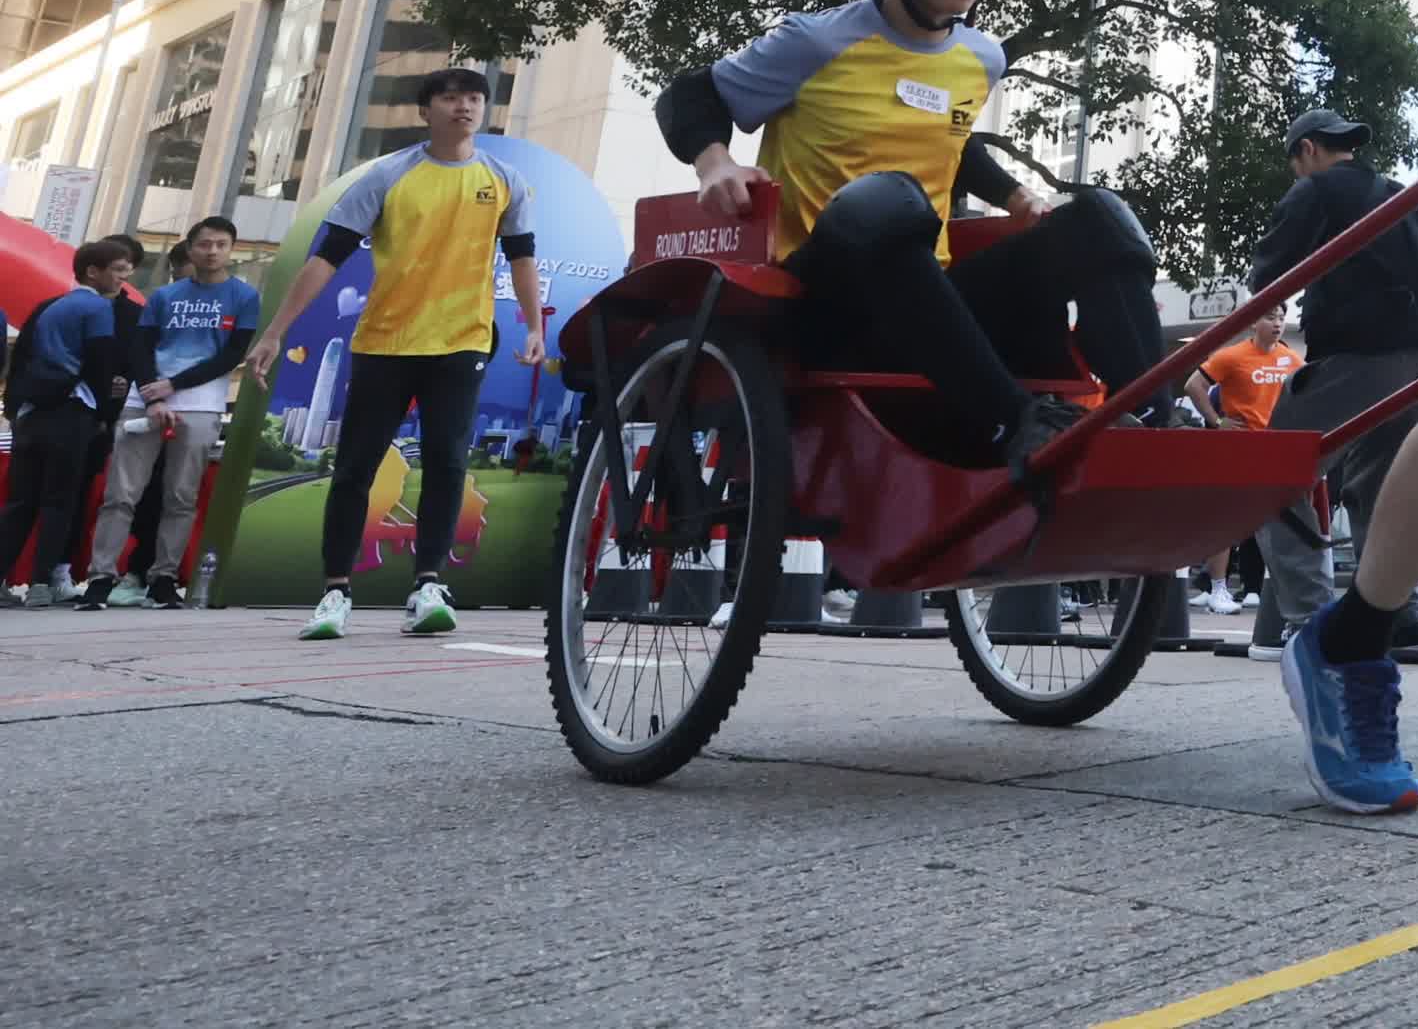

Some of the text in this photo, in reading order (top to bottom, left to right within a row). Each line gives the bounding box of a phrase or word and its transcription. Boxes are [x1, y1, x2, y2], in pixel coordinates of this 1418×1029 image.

[952, 110, 970, 125] EY
[476, 191, 490, 200] EY
[656, 226, 740, 258] ROUND TABLE NO.5
[566, 262, 609, 279] 2025
[171, 299, 222, 314] Think
[166, 314, 221, 330] Ahead
